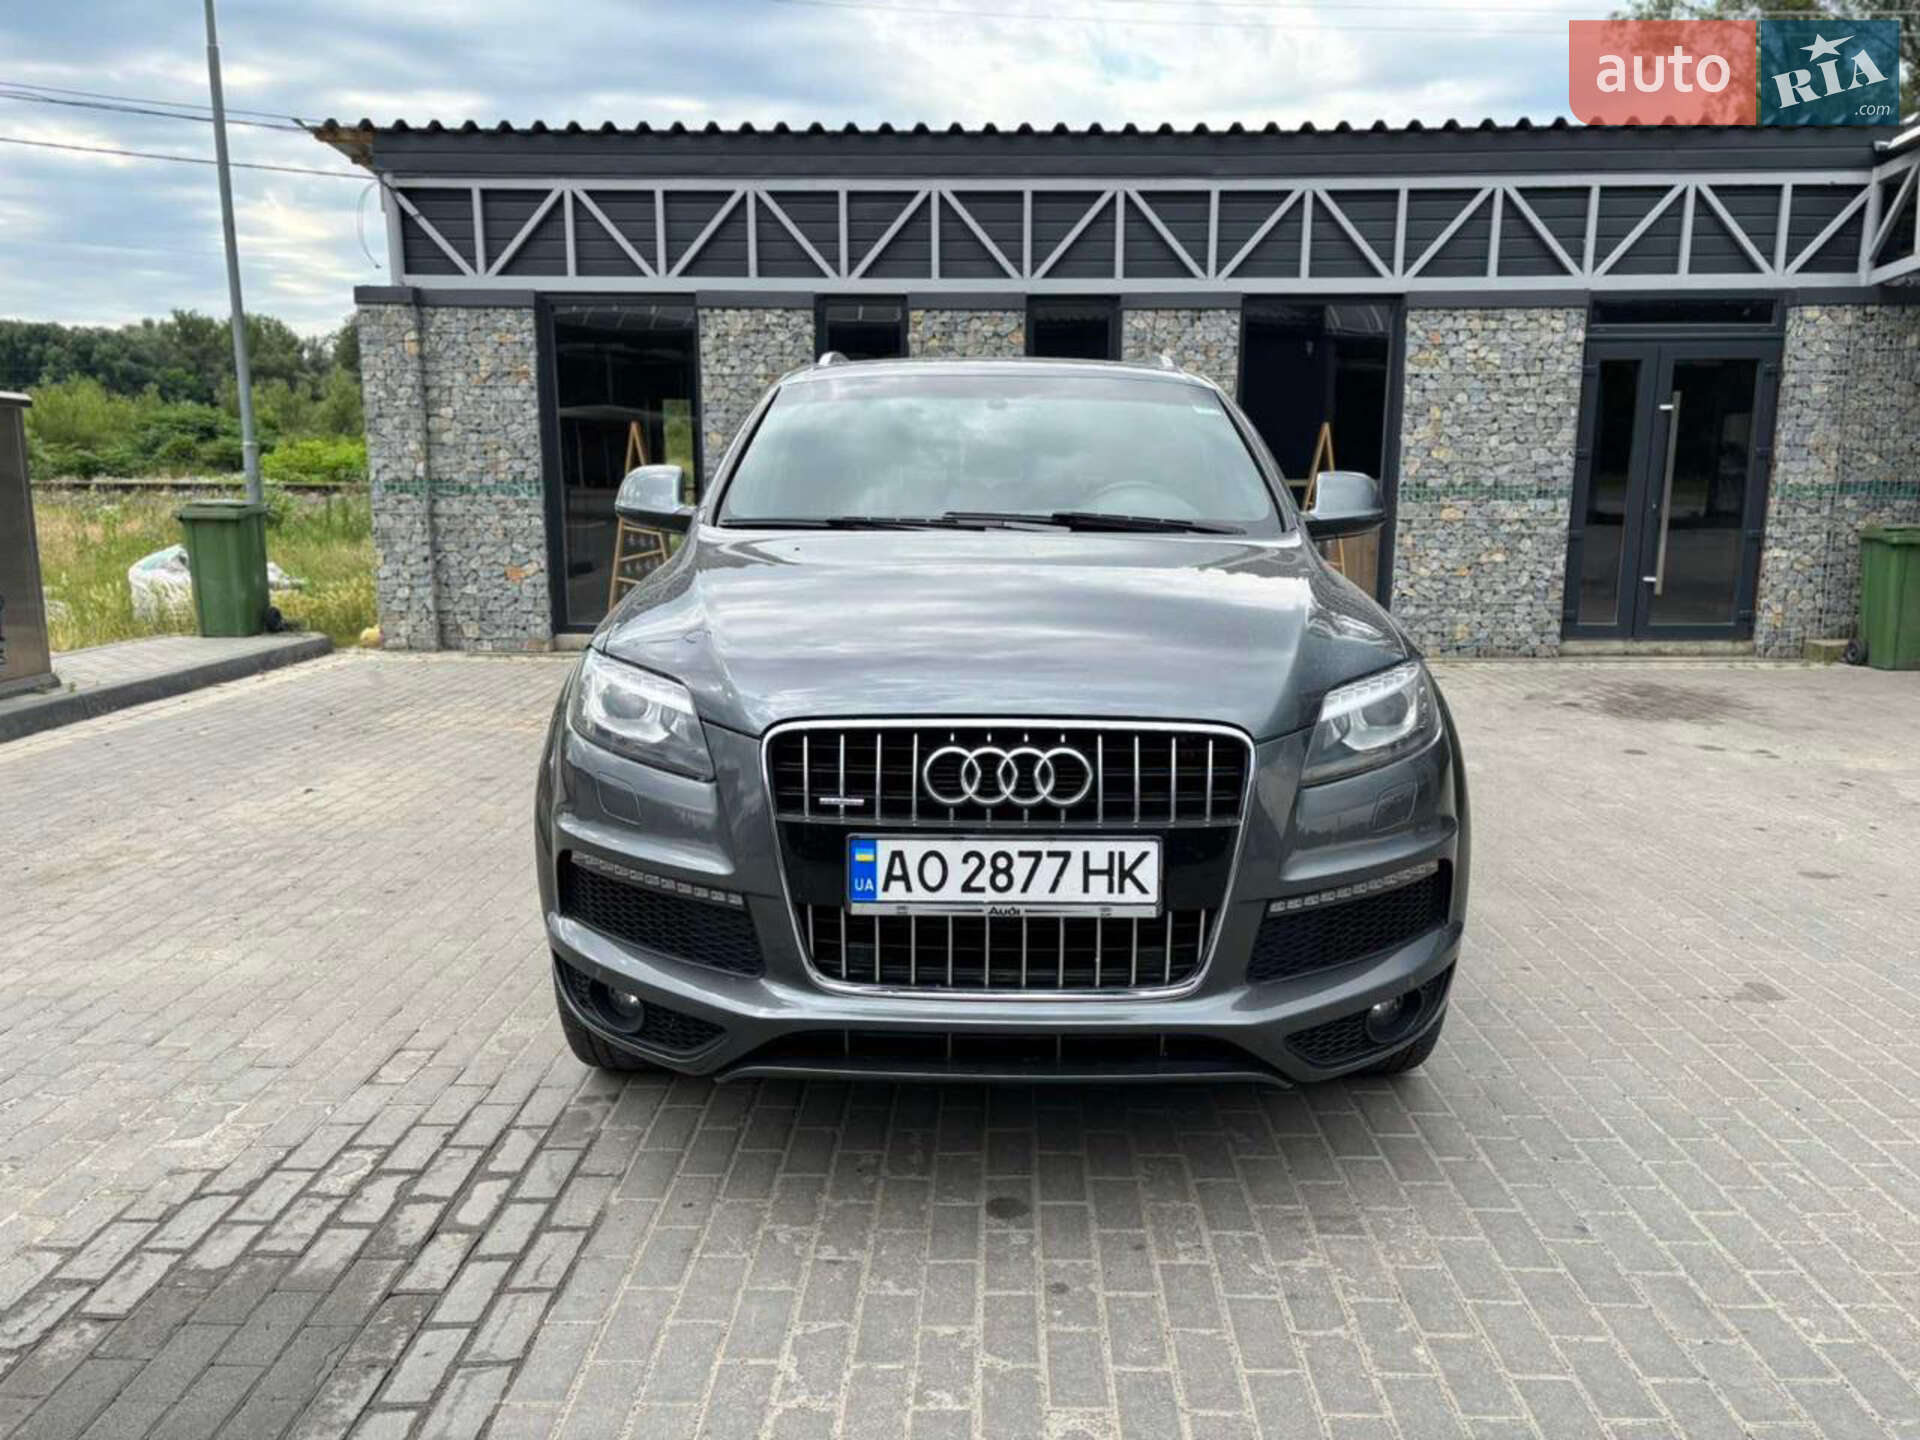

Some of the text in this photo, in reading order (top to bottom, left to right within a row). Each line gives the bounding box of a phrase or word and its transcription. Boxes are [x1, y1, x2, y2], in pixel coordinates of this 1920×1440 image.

[854, 878, 875, 892] UA
[882, 849, 1150, 895] AO 2877 HK
